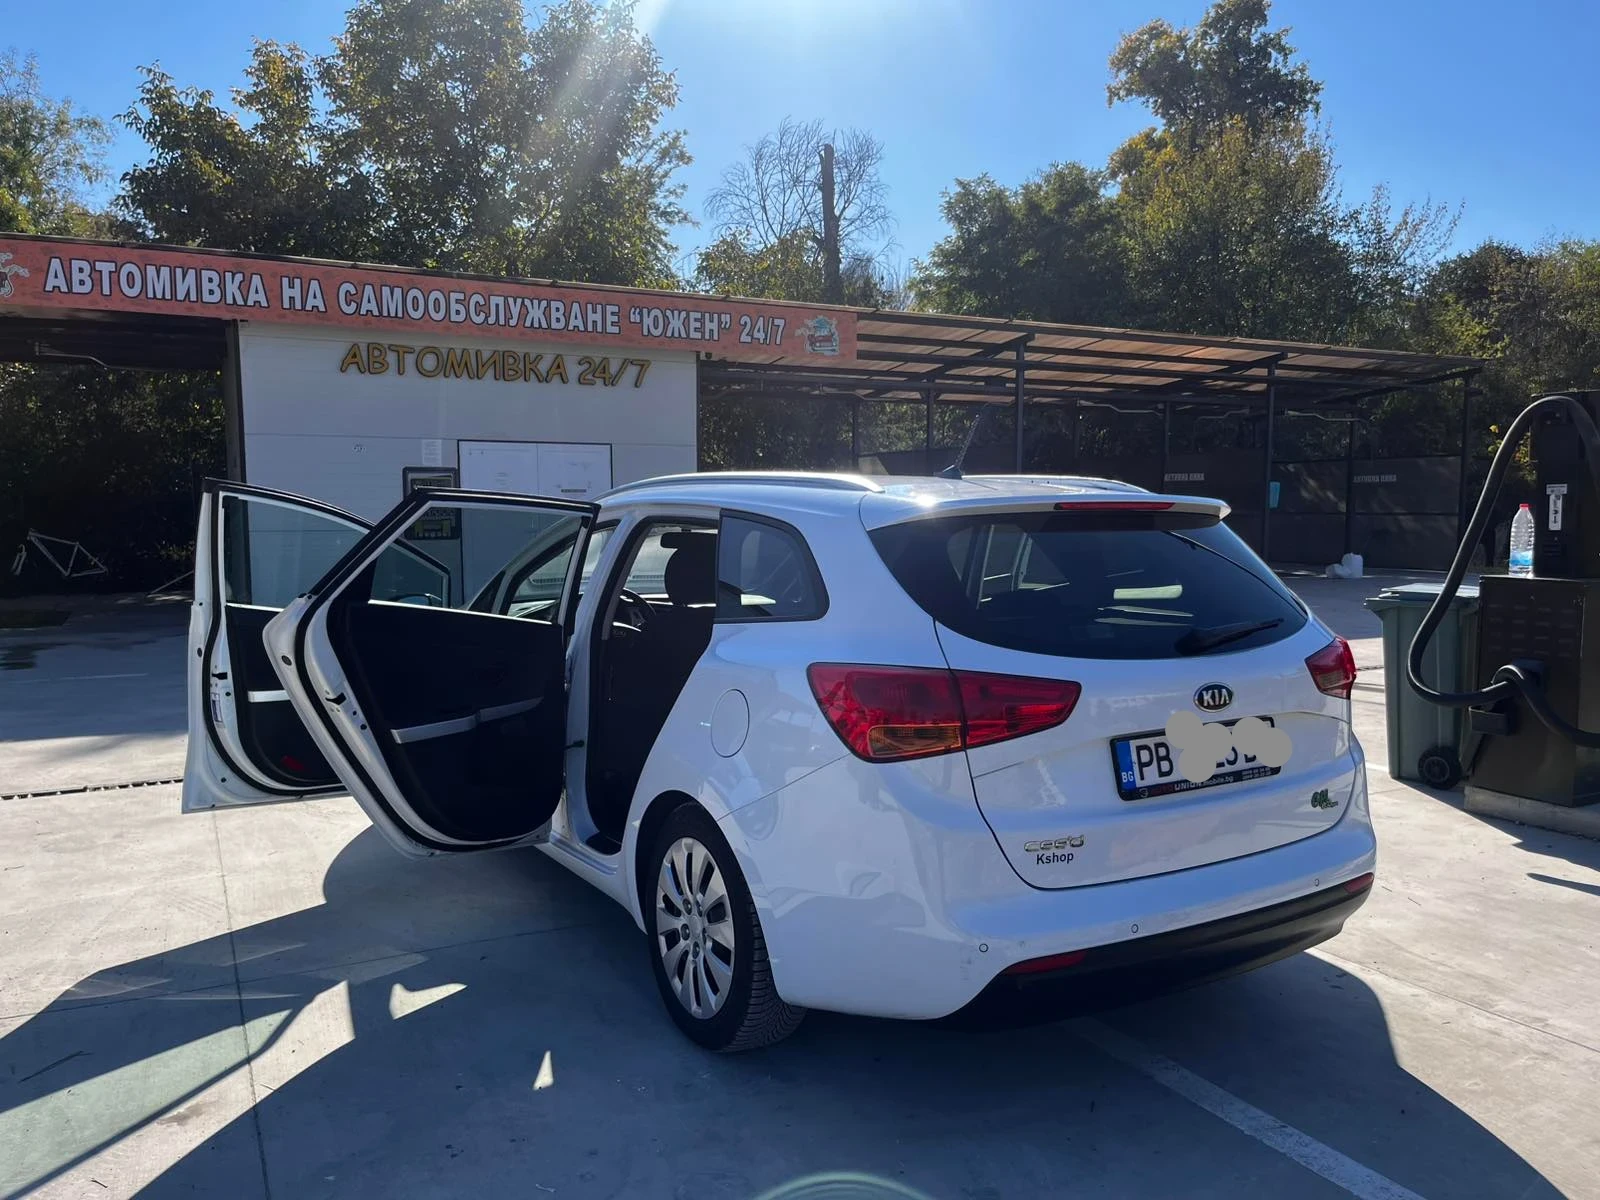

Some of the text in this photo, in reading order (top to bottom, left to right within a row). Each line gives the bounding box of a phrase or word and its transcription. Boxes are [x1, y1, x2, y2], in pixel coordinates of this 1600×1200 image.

[44, 257, 269, 308] АВТОМИВКА
[280, 275, 327, 312] НА
[338, 281, 621, 334] САМООБСЛУЖВАНЕ
[738, 315, 786, 345] 24/7
[340, 343, 651, 387] АВТОМИВКА 24/7
[1202, 689, 1229, 706] KIA
[1135, 742, 1174, 781] PB
[1121, 771, 1134, 783] BG
[1036, 852, 1074, 865] Kshop
